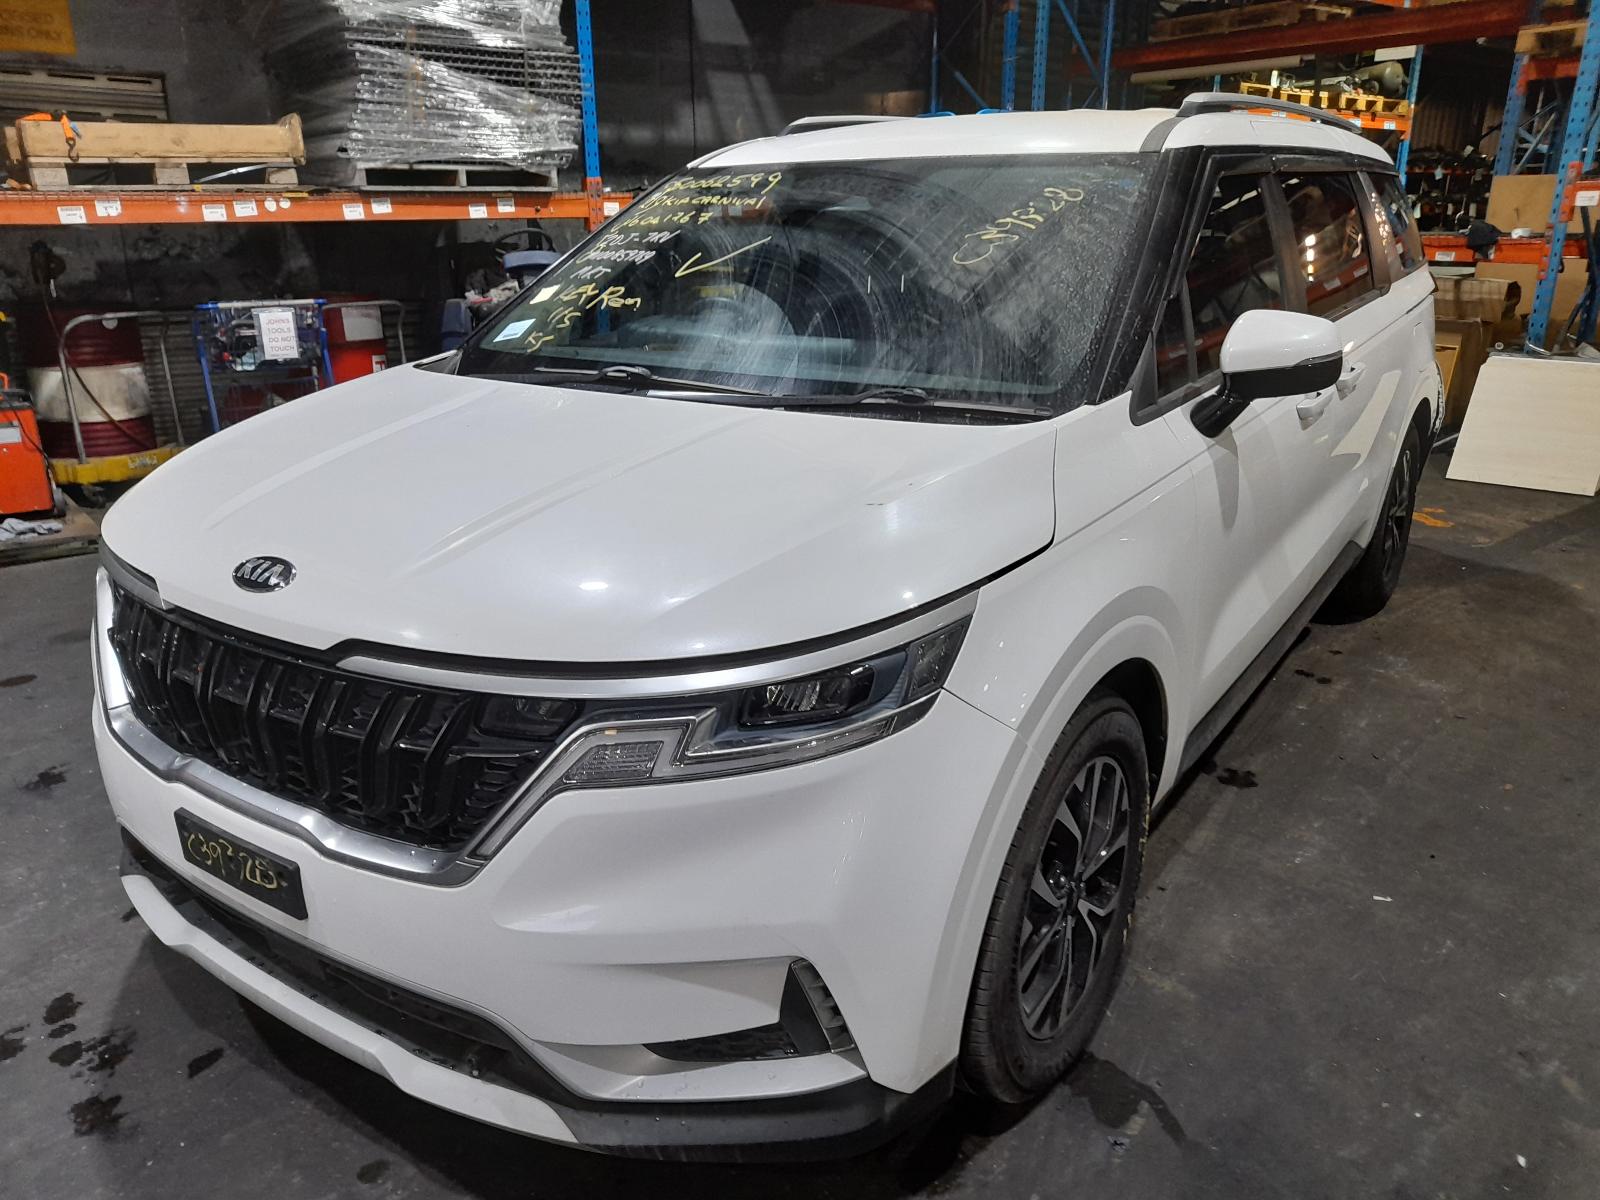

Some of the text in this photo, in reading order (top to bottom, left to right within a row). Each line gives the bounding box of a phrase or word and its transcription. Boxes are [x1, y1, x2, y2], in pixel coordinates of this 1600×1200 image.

[662, 195, 690, 206] KIA
[280, 335, 296, 343] NOT
[237, 559, 285, 586] KIA
